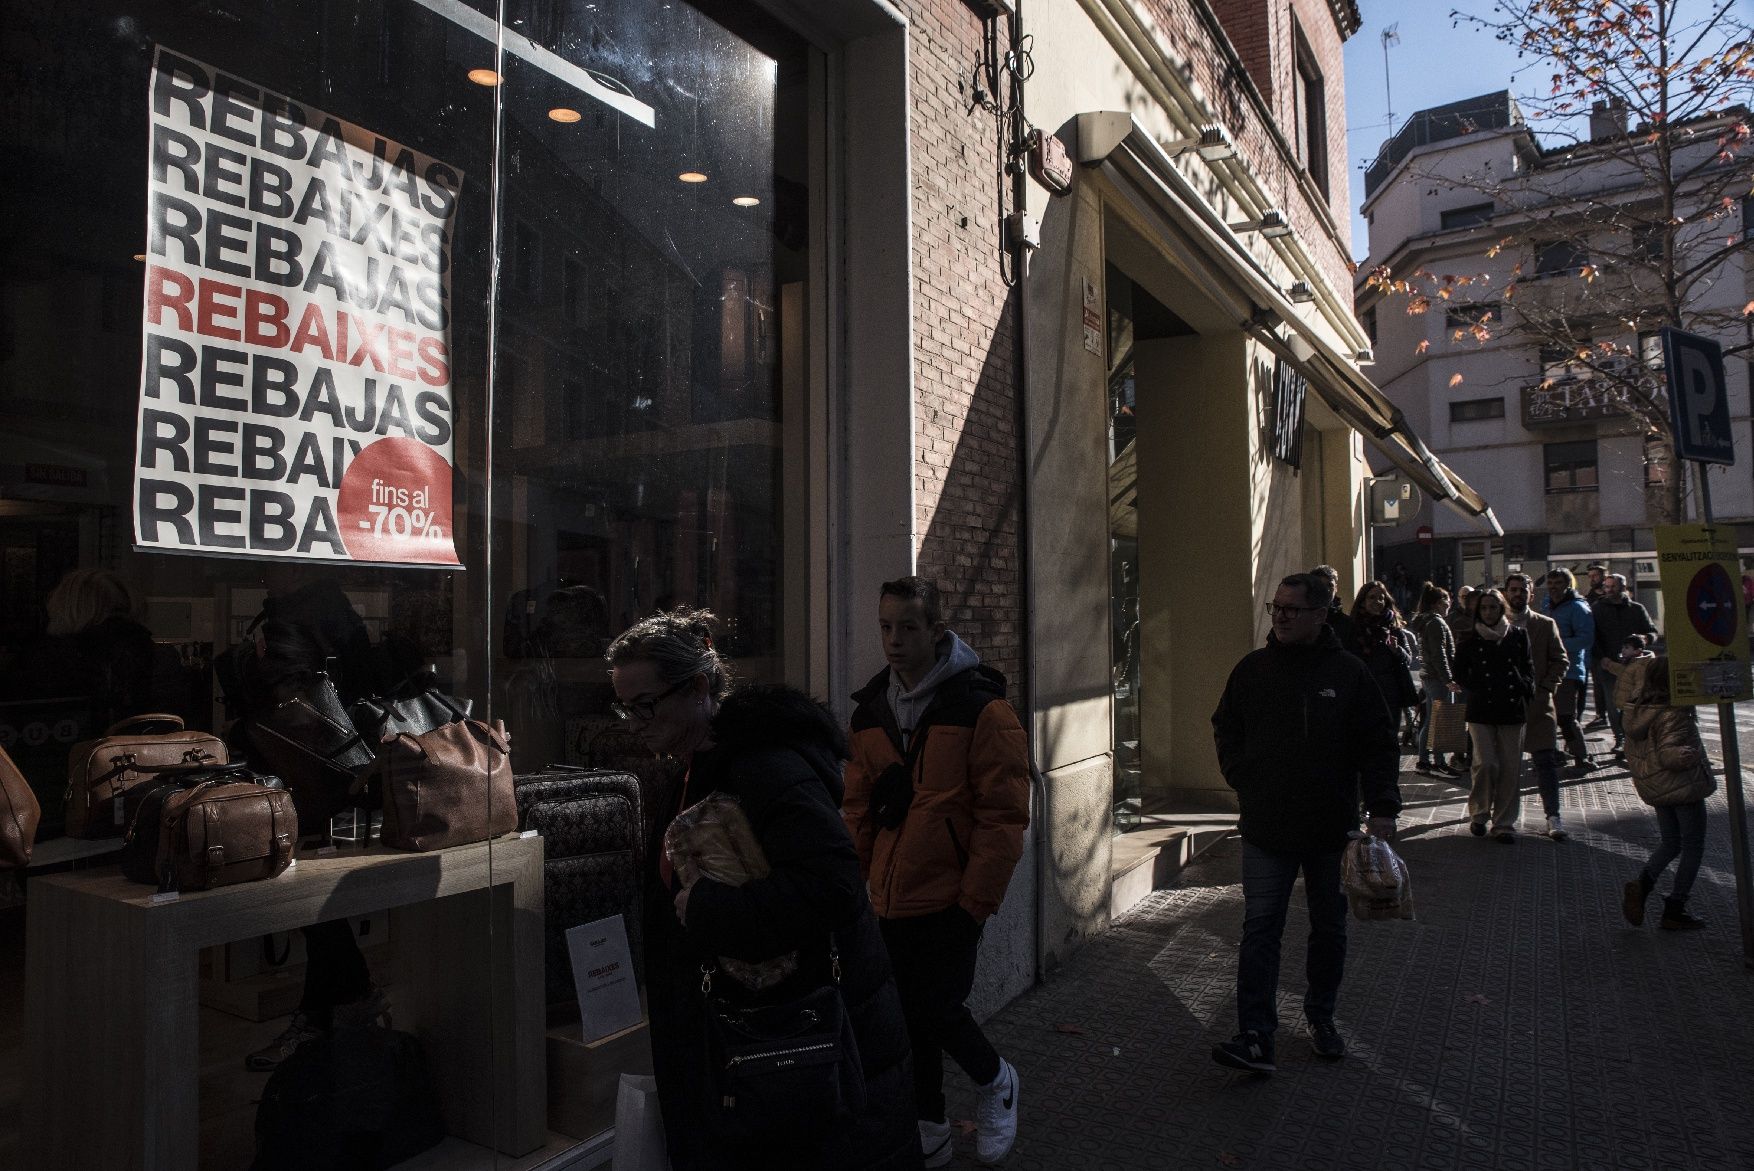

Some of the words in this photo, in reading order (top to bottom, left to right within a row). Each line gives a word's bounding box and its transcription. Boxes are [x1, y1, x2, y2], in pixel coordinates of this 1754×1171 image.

[153, 51, 459, 220] REBAJAS
[153, 122, 449, 275] REBAIXES
[150, 190, 449, 331] REBAJAS
[147, 264, 451, 387] REBAIXES
[144, 333, 452, 446] REBAJAS
[1679, 345, 1717, 447] P
[359, 504, 443, 545] -70%
[371, 478, 409, 506] fins
[412, 486, 429, 508] al
